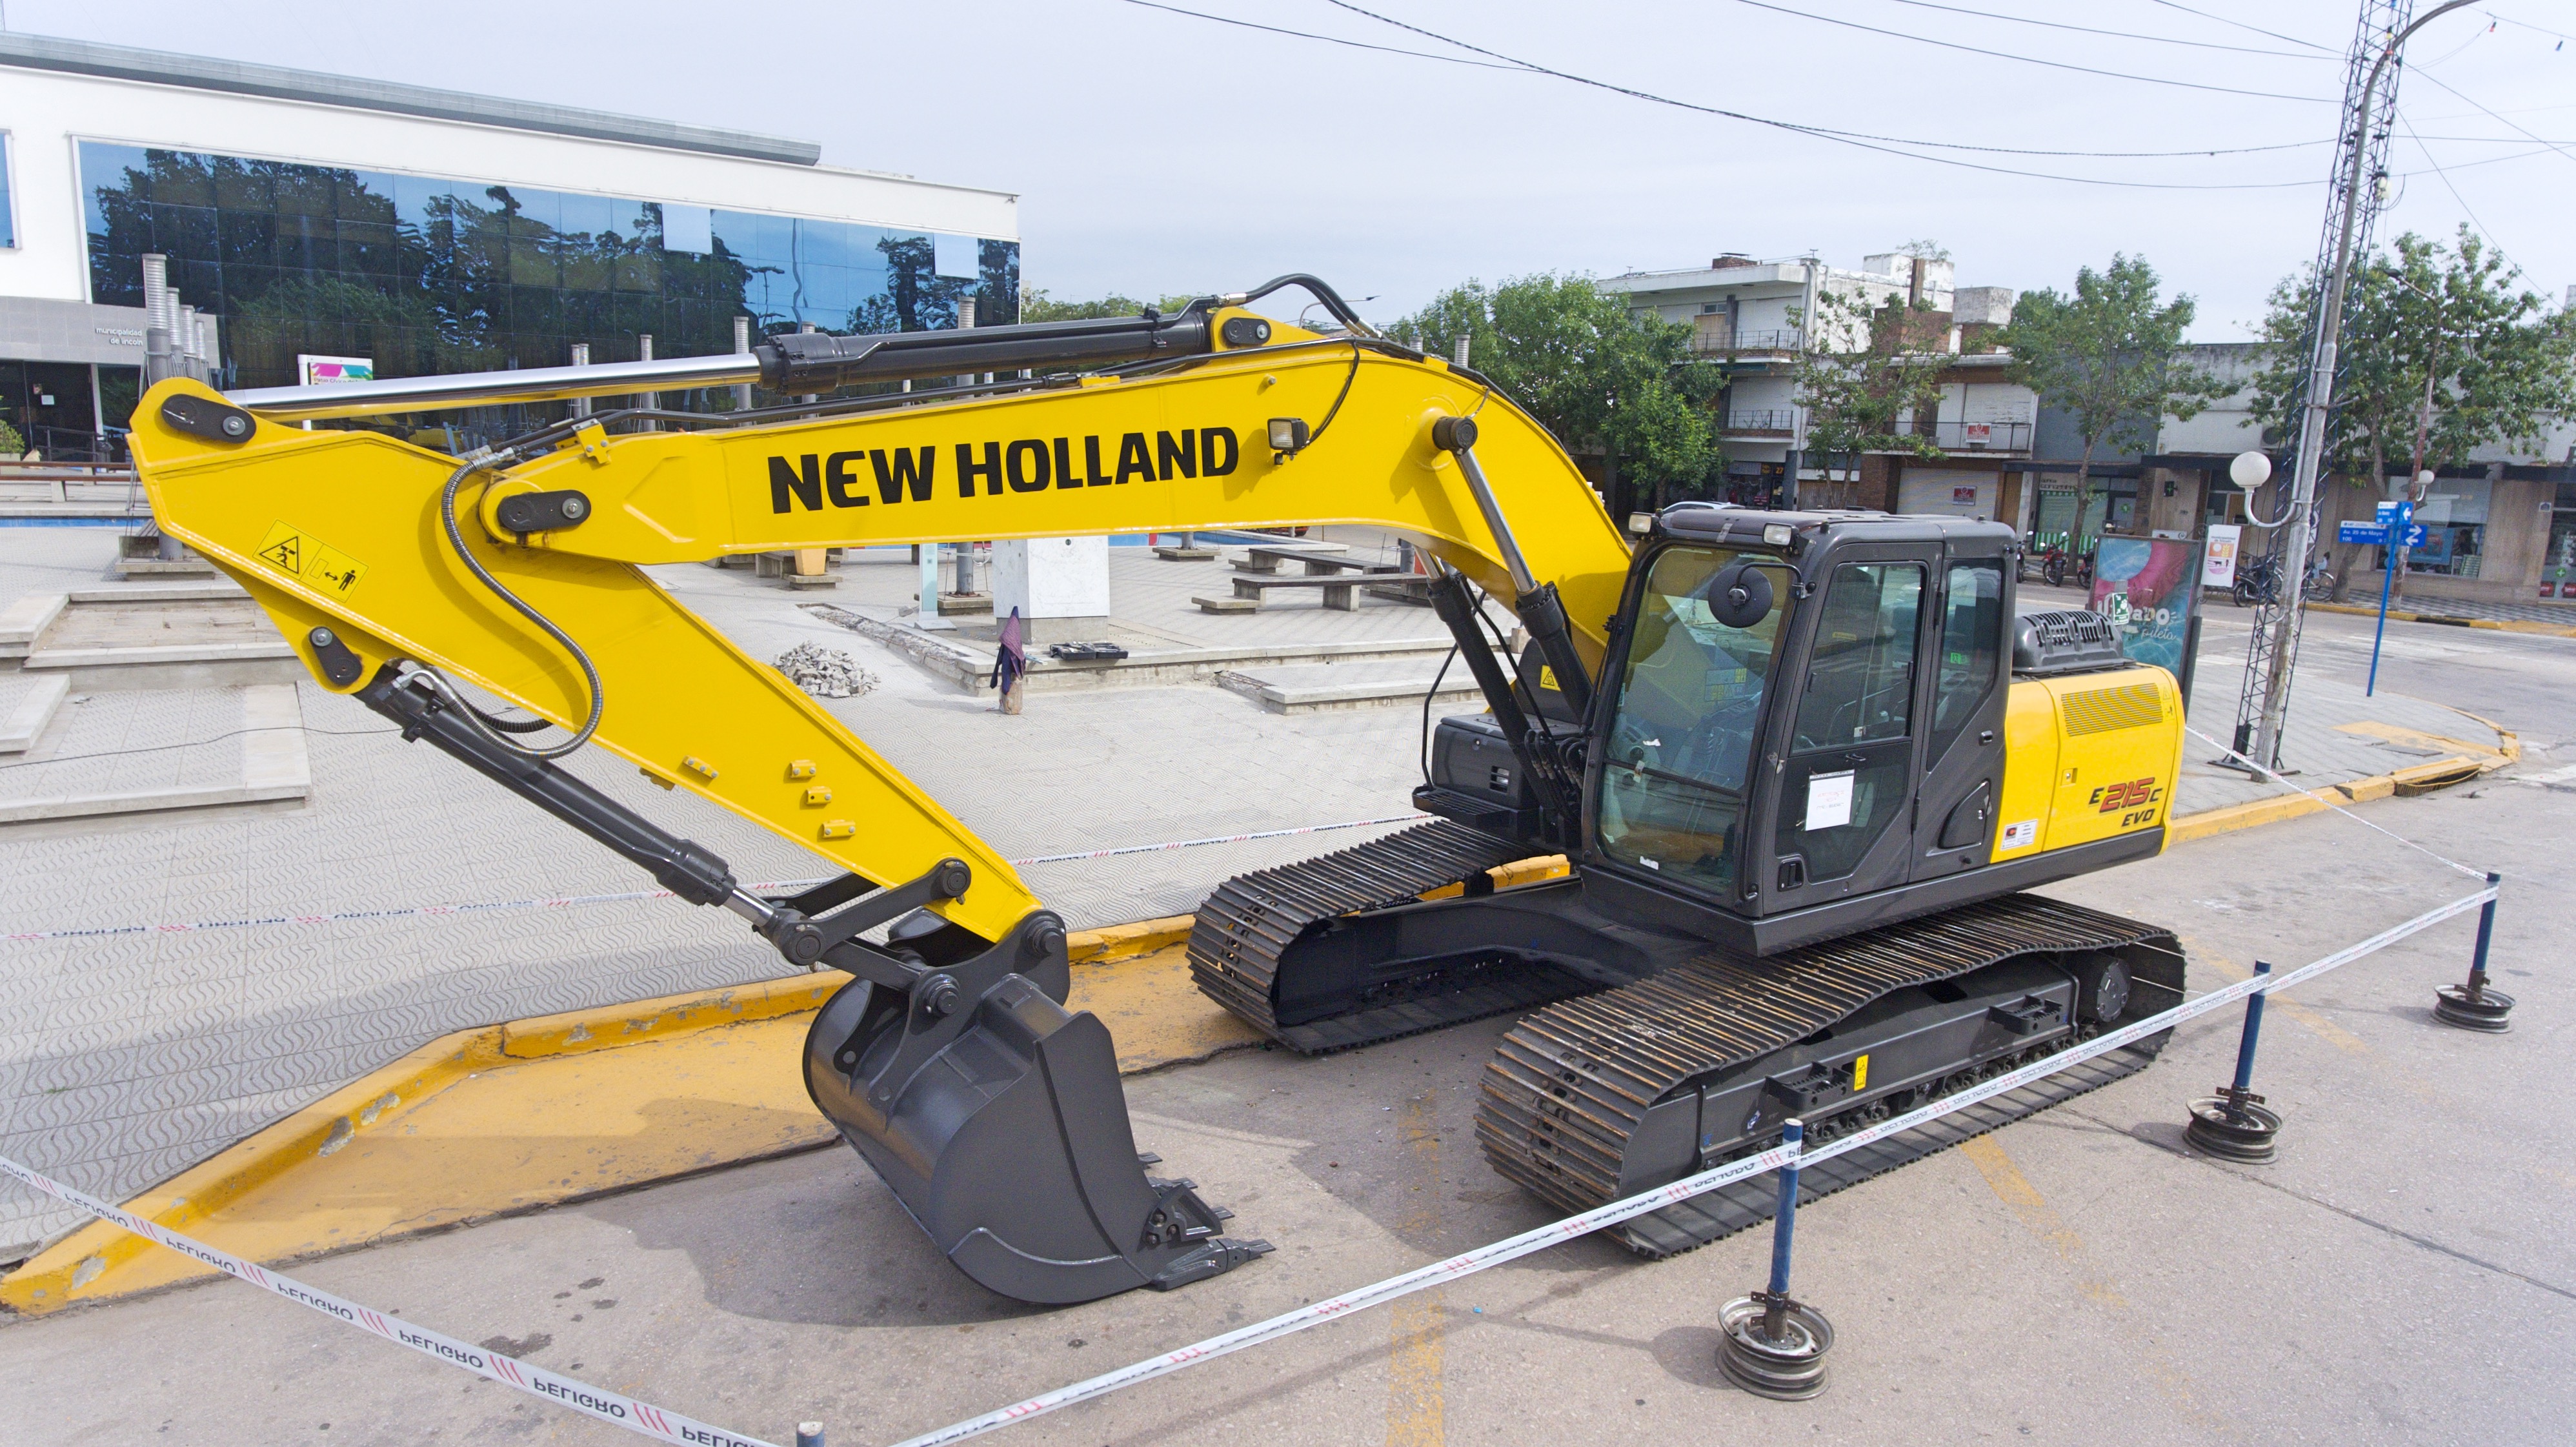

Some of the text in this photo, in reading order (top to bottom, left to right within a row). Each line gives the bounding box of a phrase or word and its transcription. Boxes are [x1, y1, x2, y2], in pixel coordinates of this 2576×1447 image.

[768, 427, 1239, 514] NEW HOLLAND
[2141, 625, 2177, 641] pileta
[2099, 777, 2155, 813] 215
[2121, 809, 2155, 827] EVO
